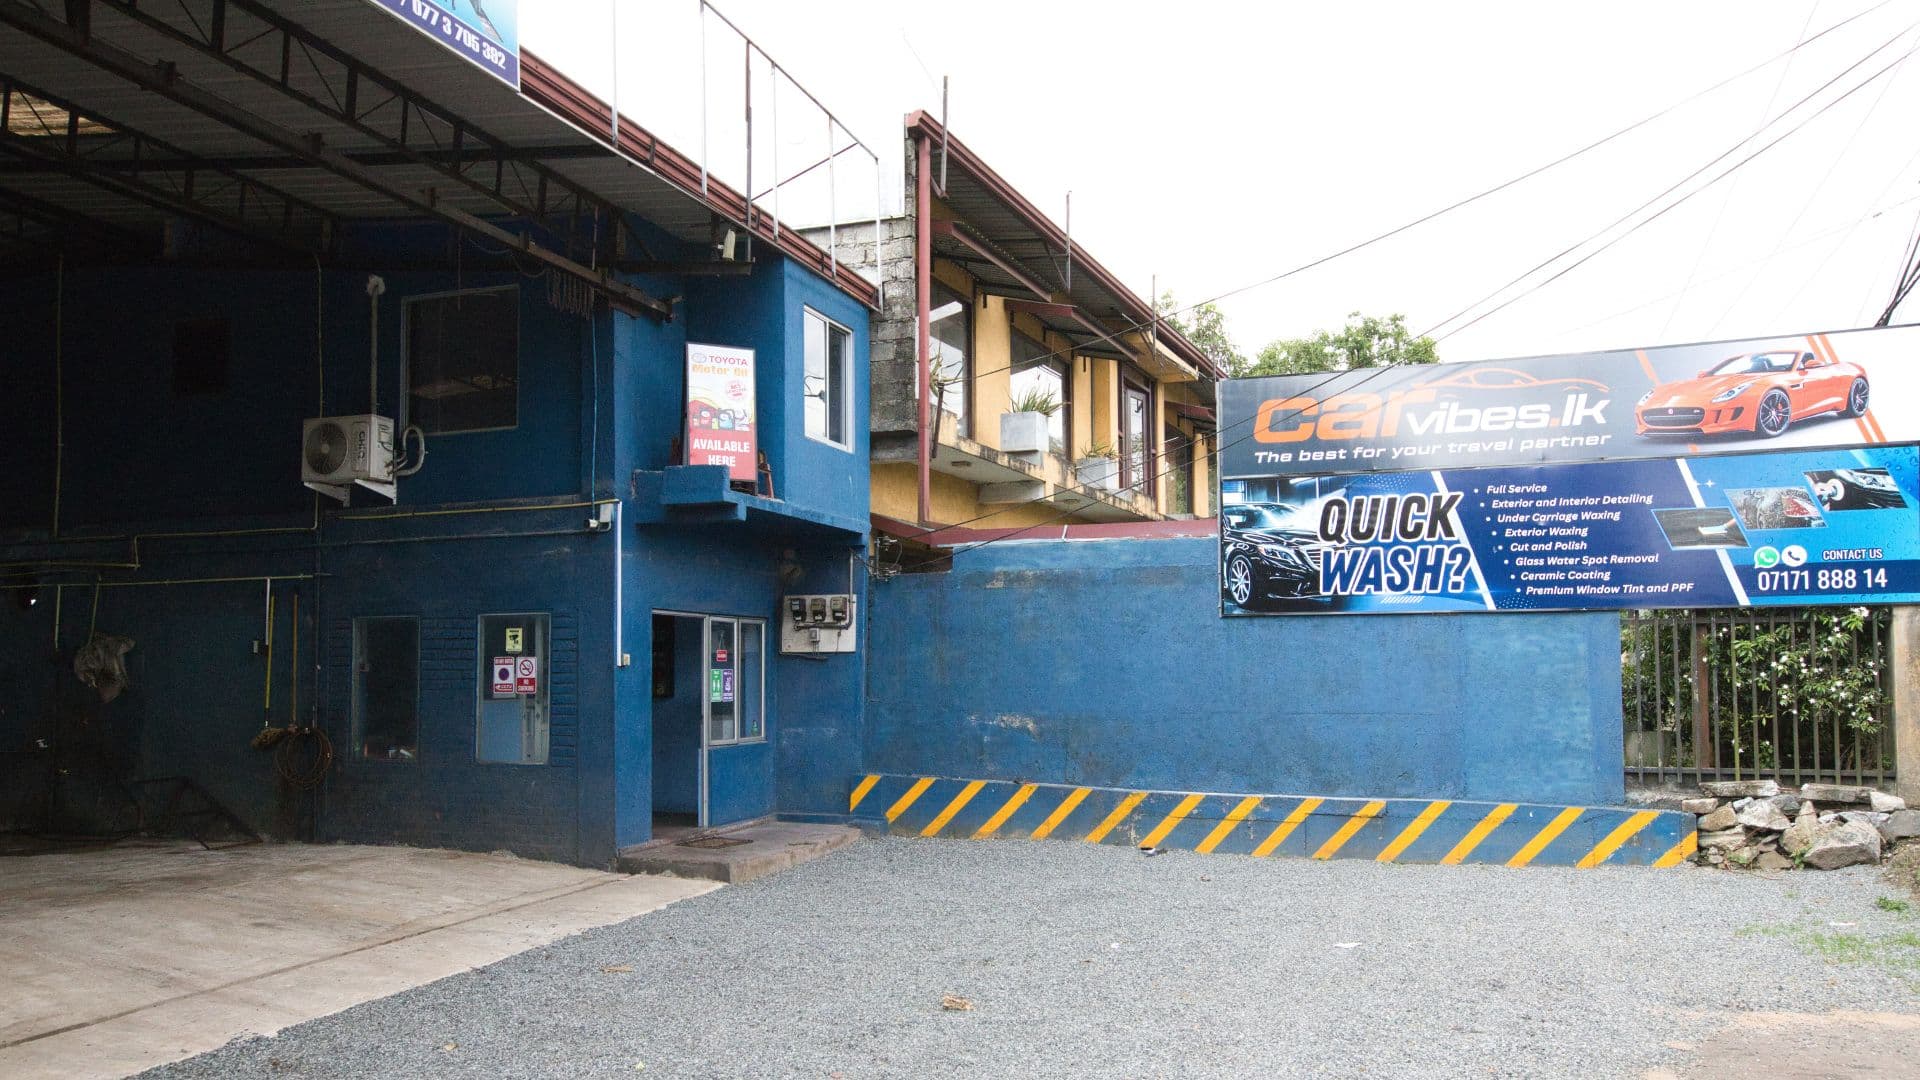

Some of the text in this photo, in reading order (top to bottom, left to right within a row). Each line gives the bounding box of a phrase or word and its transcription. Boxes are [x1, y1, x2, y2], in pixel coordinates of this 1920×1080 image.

[442, 15, 452, 35] 3
[454, 22, 480, 53] 705
[708, 355, 748, 366] TOYOTA
[692, 364, 729, 376] Motor
[694, 438, 750, 453] AVAILABLE
[1254, 435, 1612, 464] The best for your travel partner
[708, 455, 736, 466] HERE
[1486, 484, 1548, 494] Full Service
[1492, 494, 1654, 509] Exterior and Interior Detailing
[1319, 492, 1463, 545] QUICK
[1497, 510, 1621, 523] Under Carriage Waxing
[1505, 526, 1589, 538] Exterior Waxing
[1510, 540, 1588, 552] Cut and Polish
[1515, 553, 1659, 566] Glass Water Spot Removal
[1822, 548, 1883, 560] CONTACT US
[1320, 544, 1472, 594] WASH?
[1520, 570, 1612, 581] Ceramic Coating
[1757, 567, 1888, 590] 07171 888 14
[1526, 582, 1695, 596] Premium Window Tint and PPF
